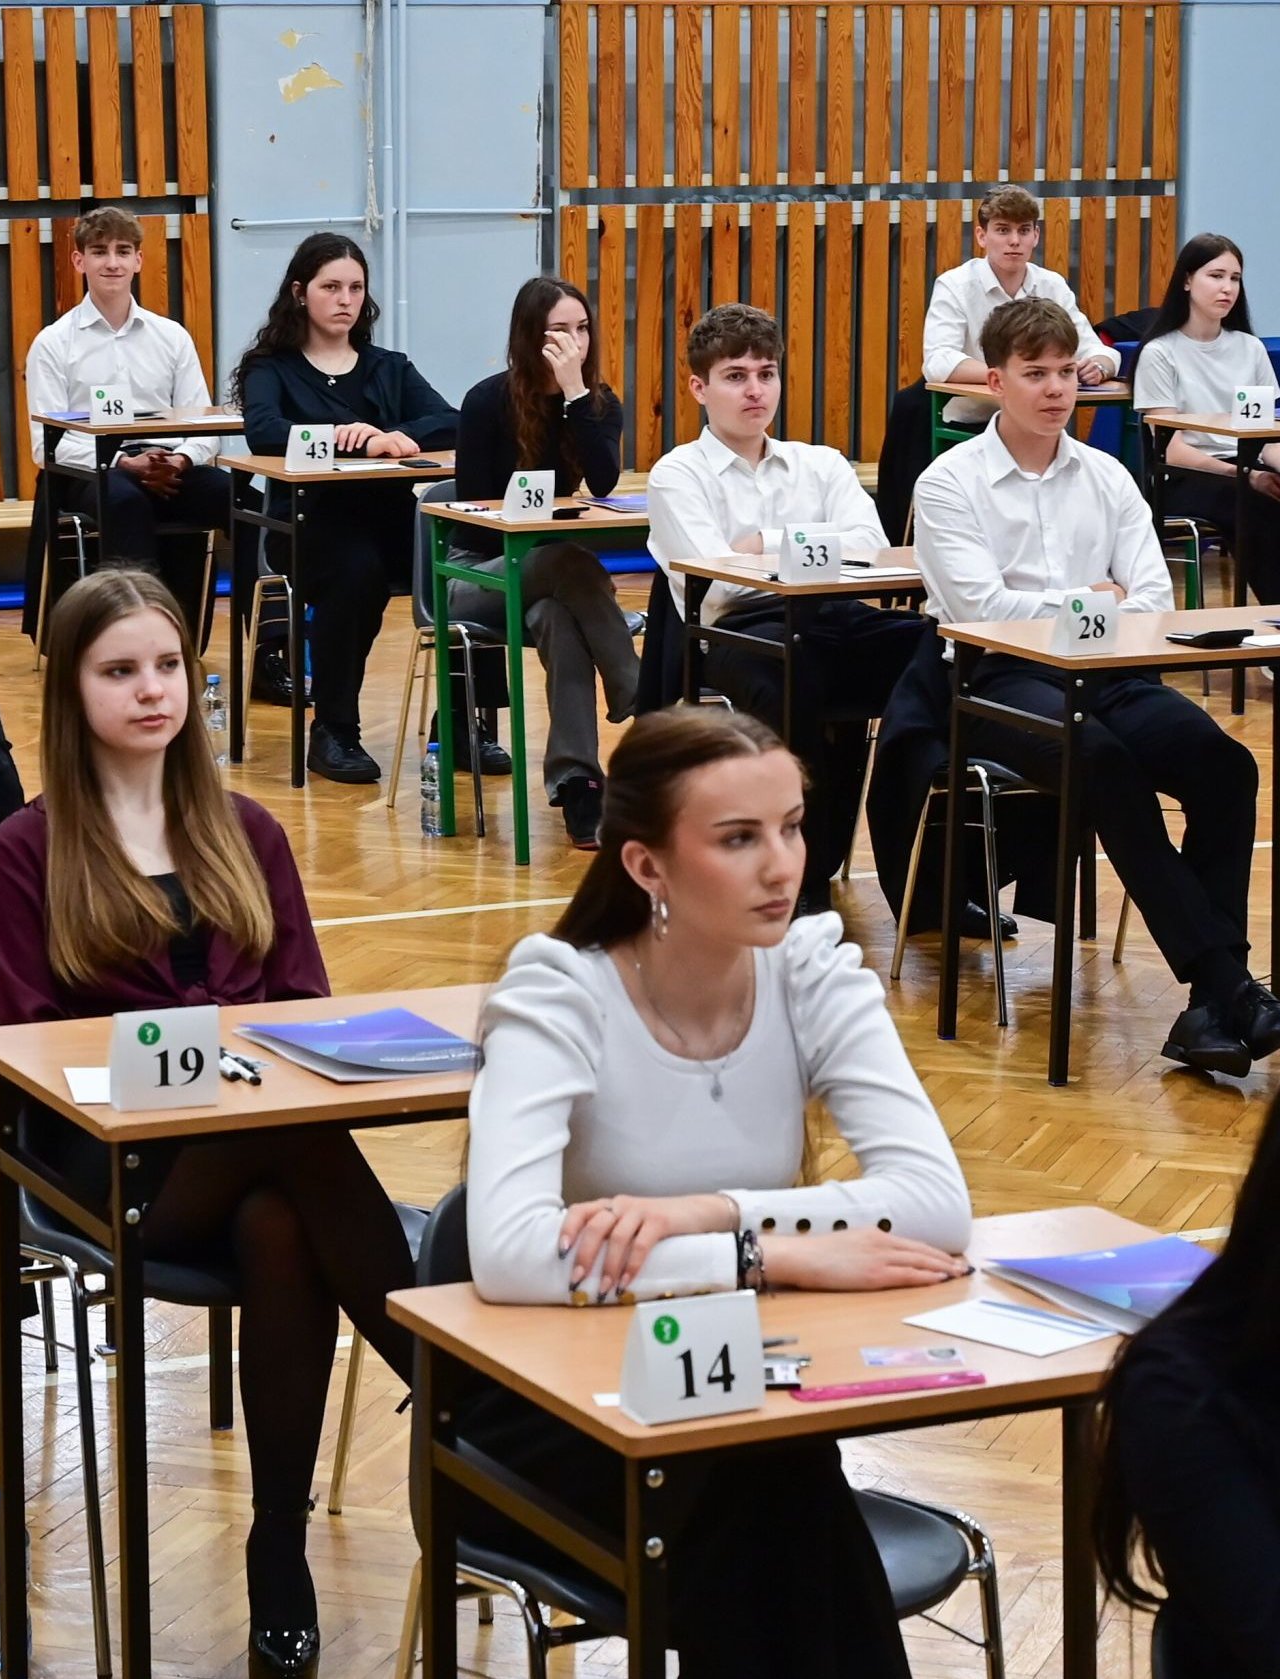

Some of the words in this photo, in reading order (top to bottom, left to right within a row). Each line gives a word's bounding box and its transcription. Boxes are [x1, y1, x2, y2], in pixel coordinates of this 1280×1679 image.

[102, 398, 124, 416] 48
[1240, 402, 1261, 419] 42
[305, 441, 328, 460] 43
[521, 488, 545, 509] 38
[802, 544, 829, 568] 33
[1078, 614, 1106, 640] 28
[156, 1046, 205, 1087] 19
[678, 1343, 736, 1400] 14
